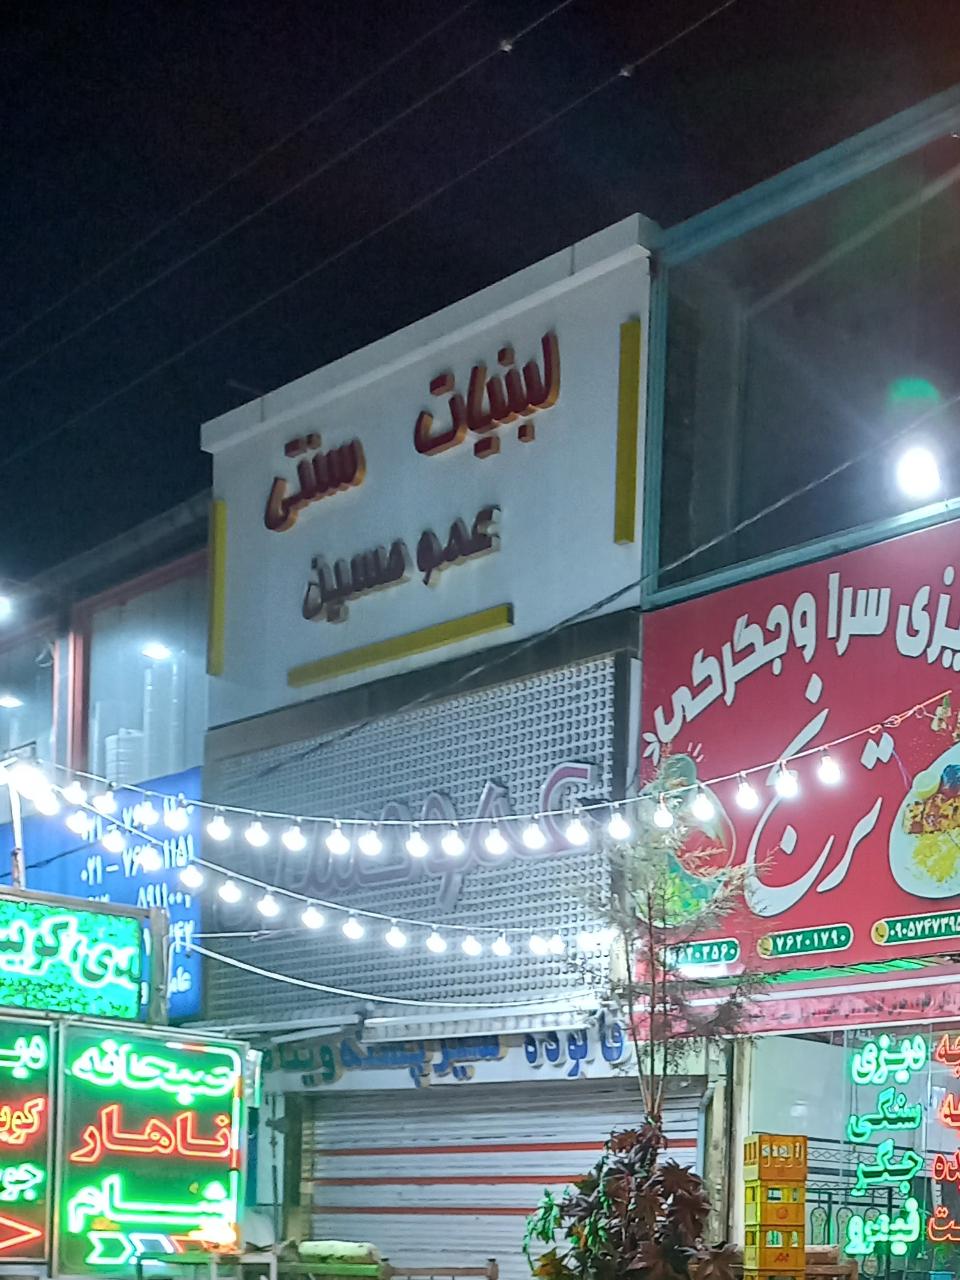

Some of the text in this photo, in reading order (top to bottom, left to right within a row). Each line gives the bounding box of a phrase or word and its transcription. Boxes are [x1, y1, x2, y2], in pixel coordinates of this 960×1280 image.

[264, 330, 561, 532] لبنیات سنتی
[417, 504, 502, 587] عمو
[827, 572, 891, 656] سرا
[775, 929, 847, 953] ۷۶۲۰۱۷۹۰
[69, 1103, 234, 1163] ناهار
[847, 1086, 923, 1143] سنگی
